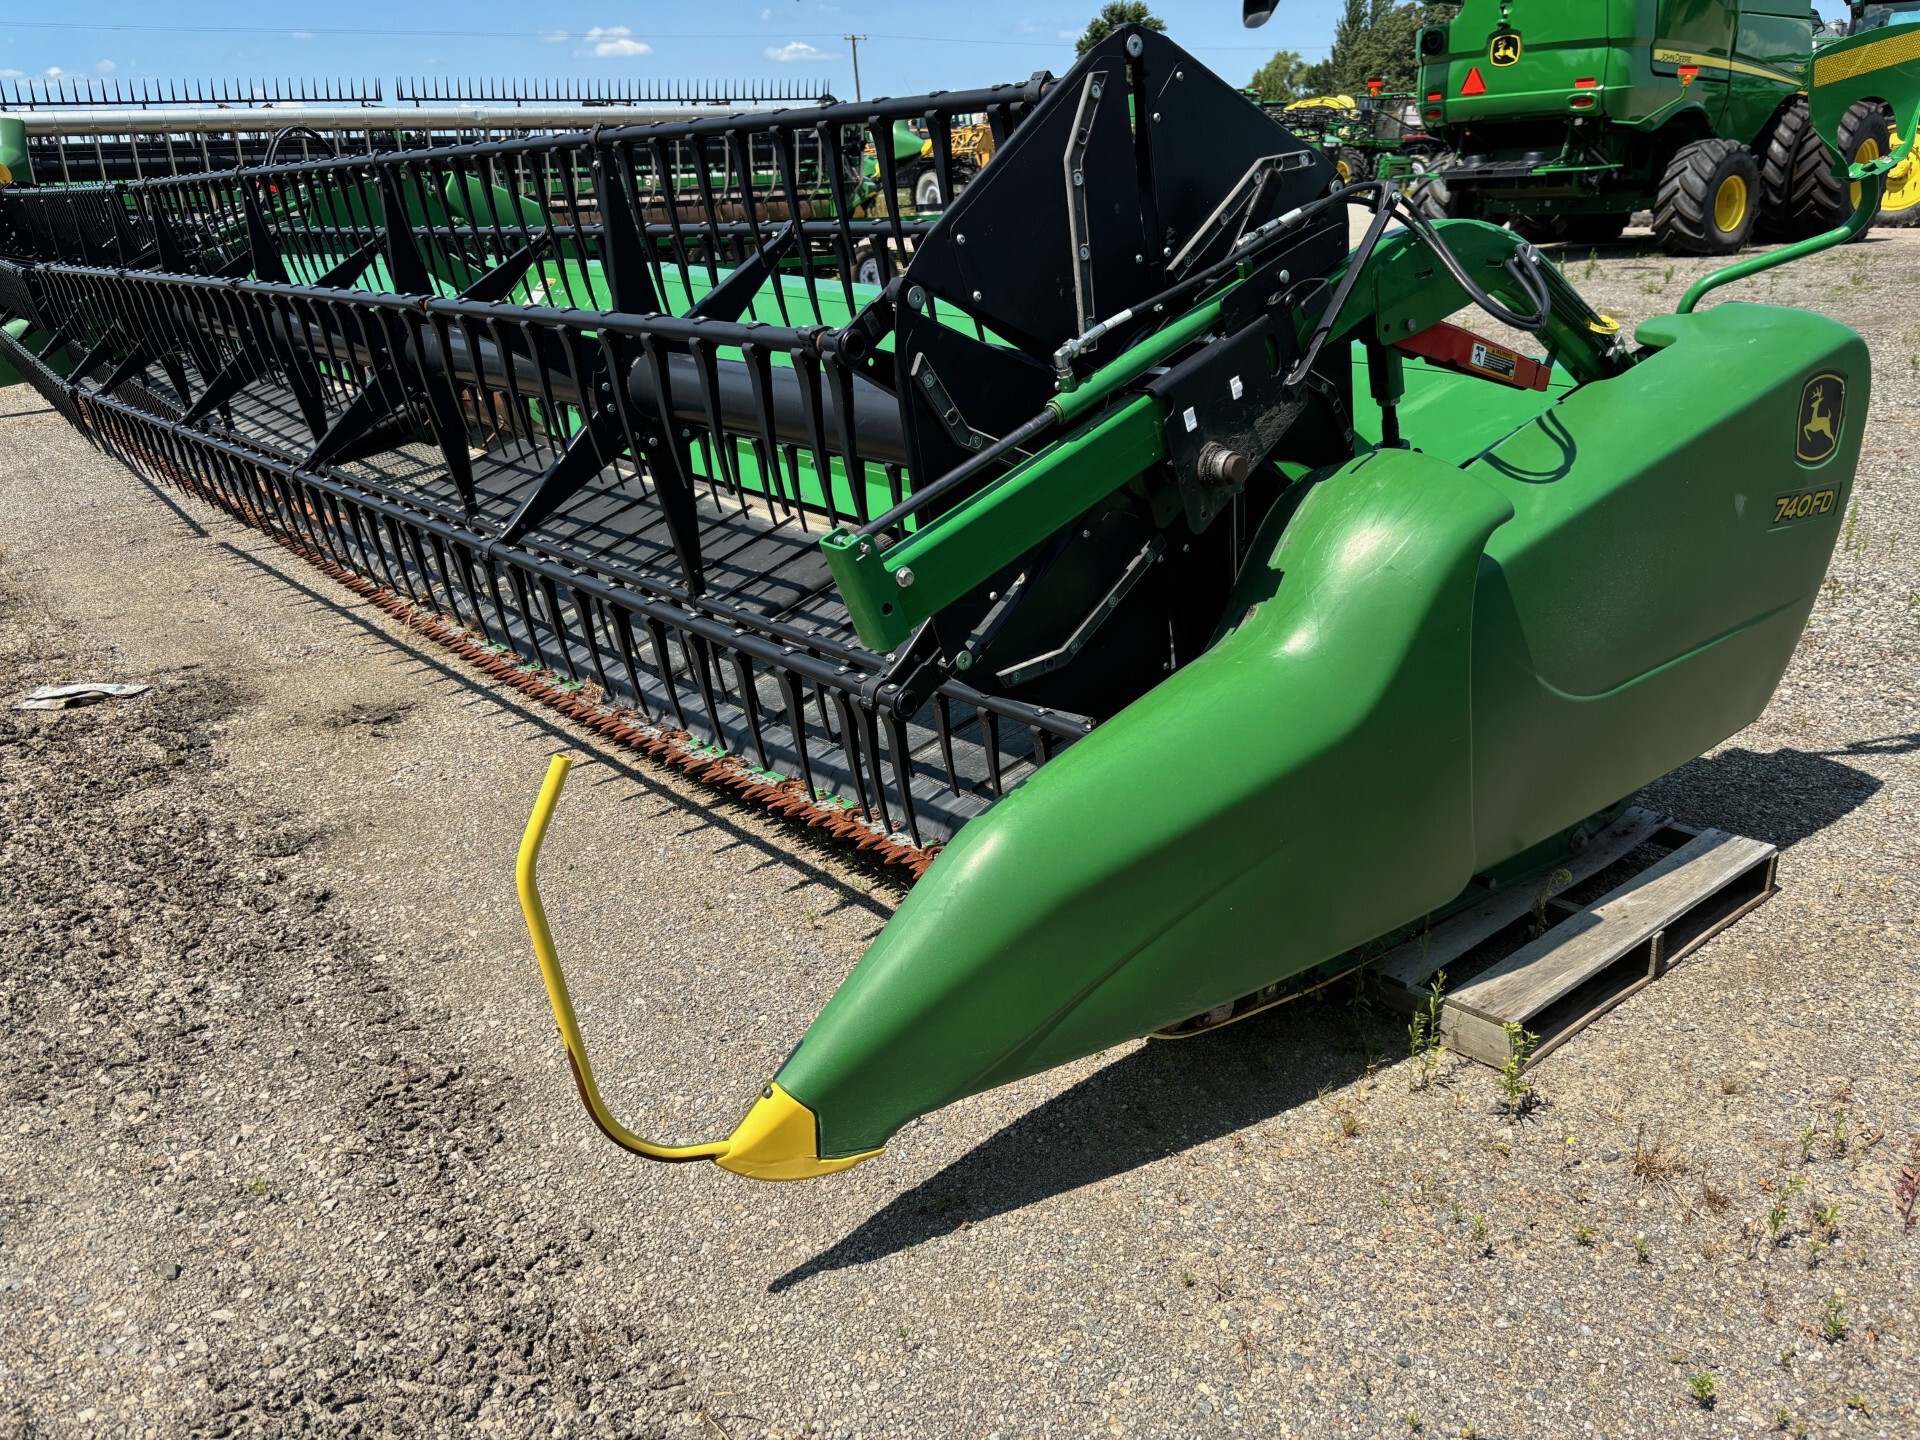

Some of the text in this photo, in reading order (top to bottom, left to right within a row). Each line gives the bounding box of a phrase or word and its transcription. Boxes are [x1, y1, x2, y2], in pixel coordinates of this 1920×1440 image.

[1660, 52, 1692, 64] JOHN DEERE
[1495, 349, 1513, 360] WARNING
[1773, 490, 1834, 523] 740FD
